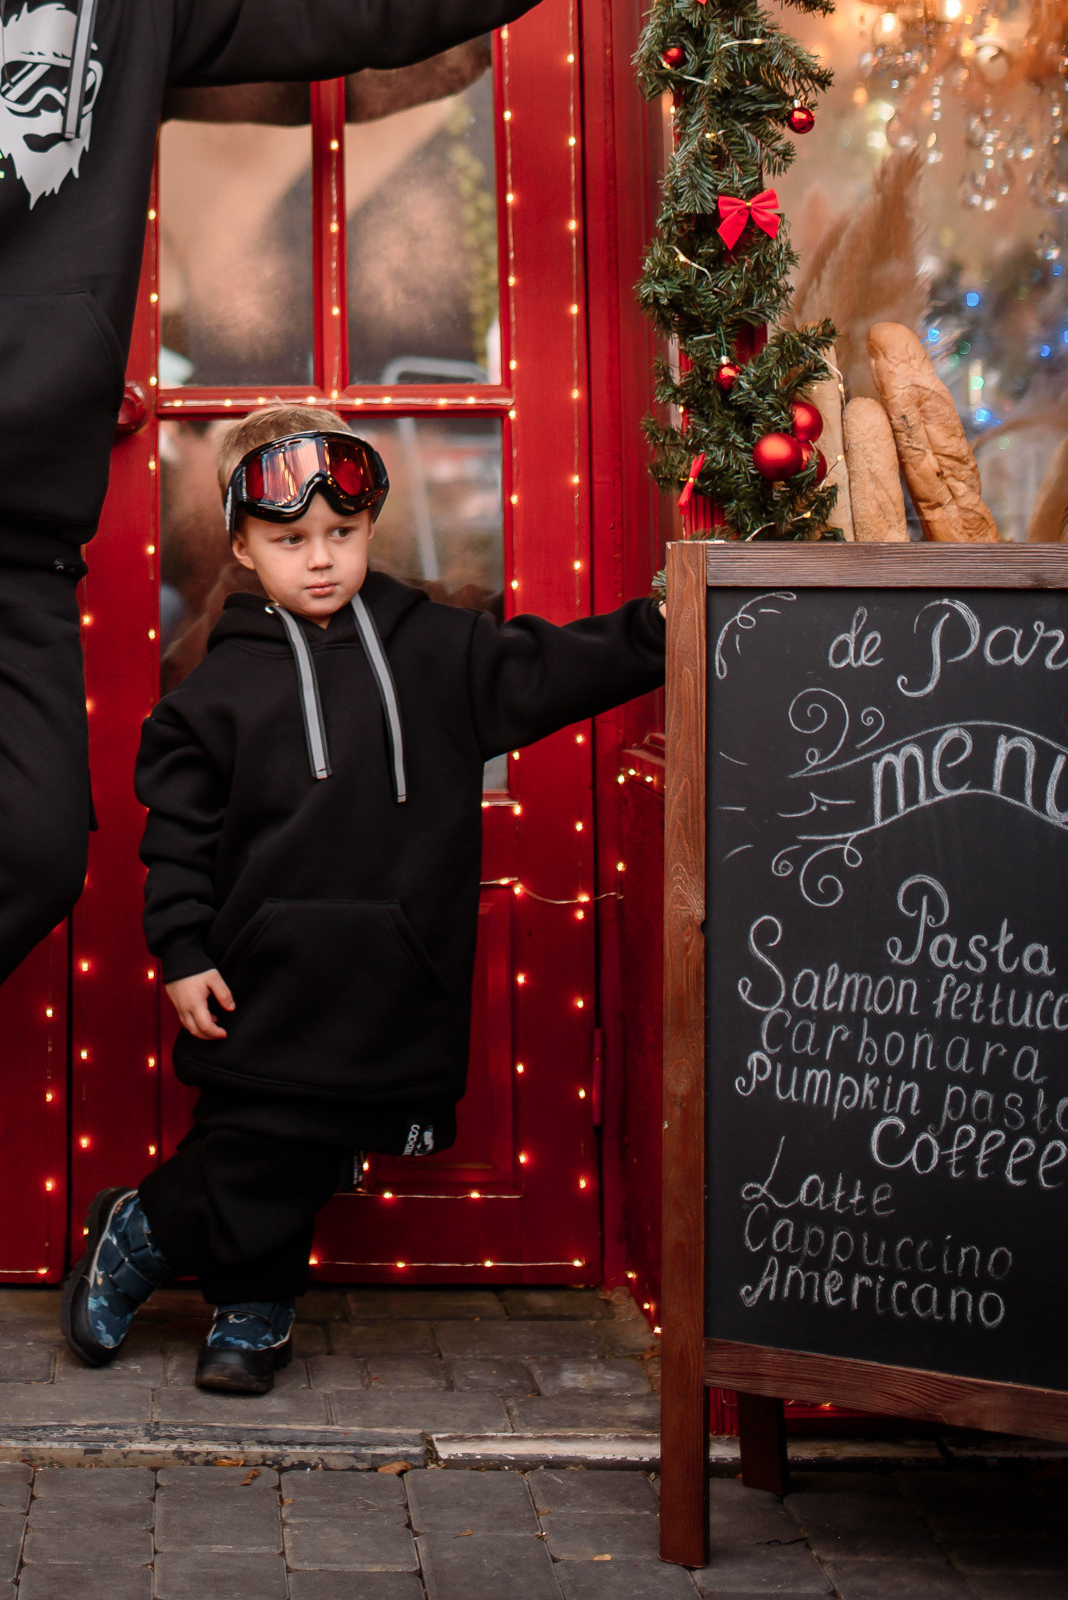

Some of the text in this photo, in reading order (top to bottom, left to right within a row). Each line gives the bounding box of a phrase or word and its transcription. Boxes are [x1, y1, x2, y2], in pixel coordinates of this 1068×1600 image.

[828, 598, 1068, 697] de Par
[886, 874, 1056, 976] Pasta
[738, 914, 920, 1015] Salmon
[761, 1008, 1048, 1084] Carbonara
[735, 1051, 921, 1120] Pumpkin
[741, 1136, 896, 1216] Latte
[871, 1116, 1068, 1188] Coffee
[744, 1202, 1013, 1280] Cappuccino
[740, 1256, 1005, 1328] Americano
